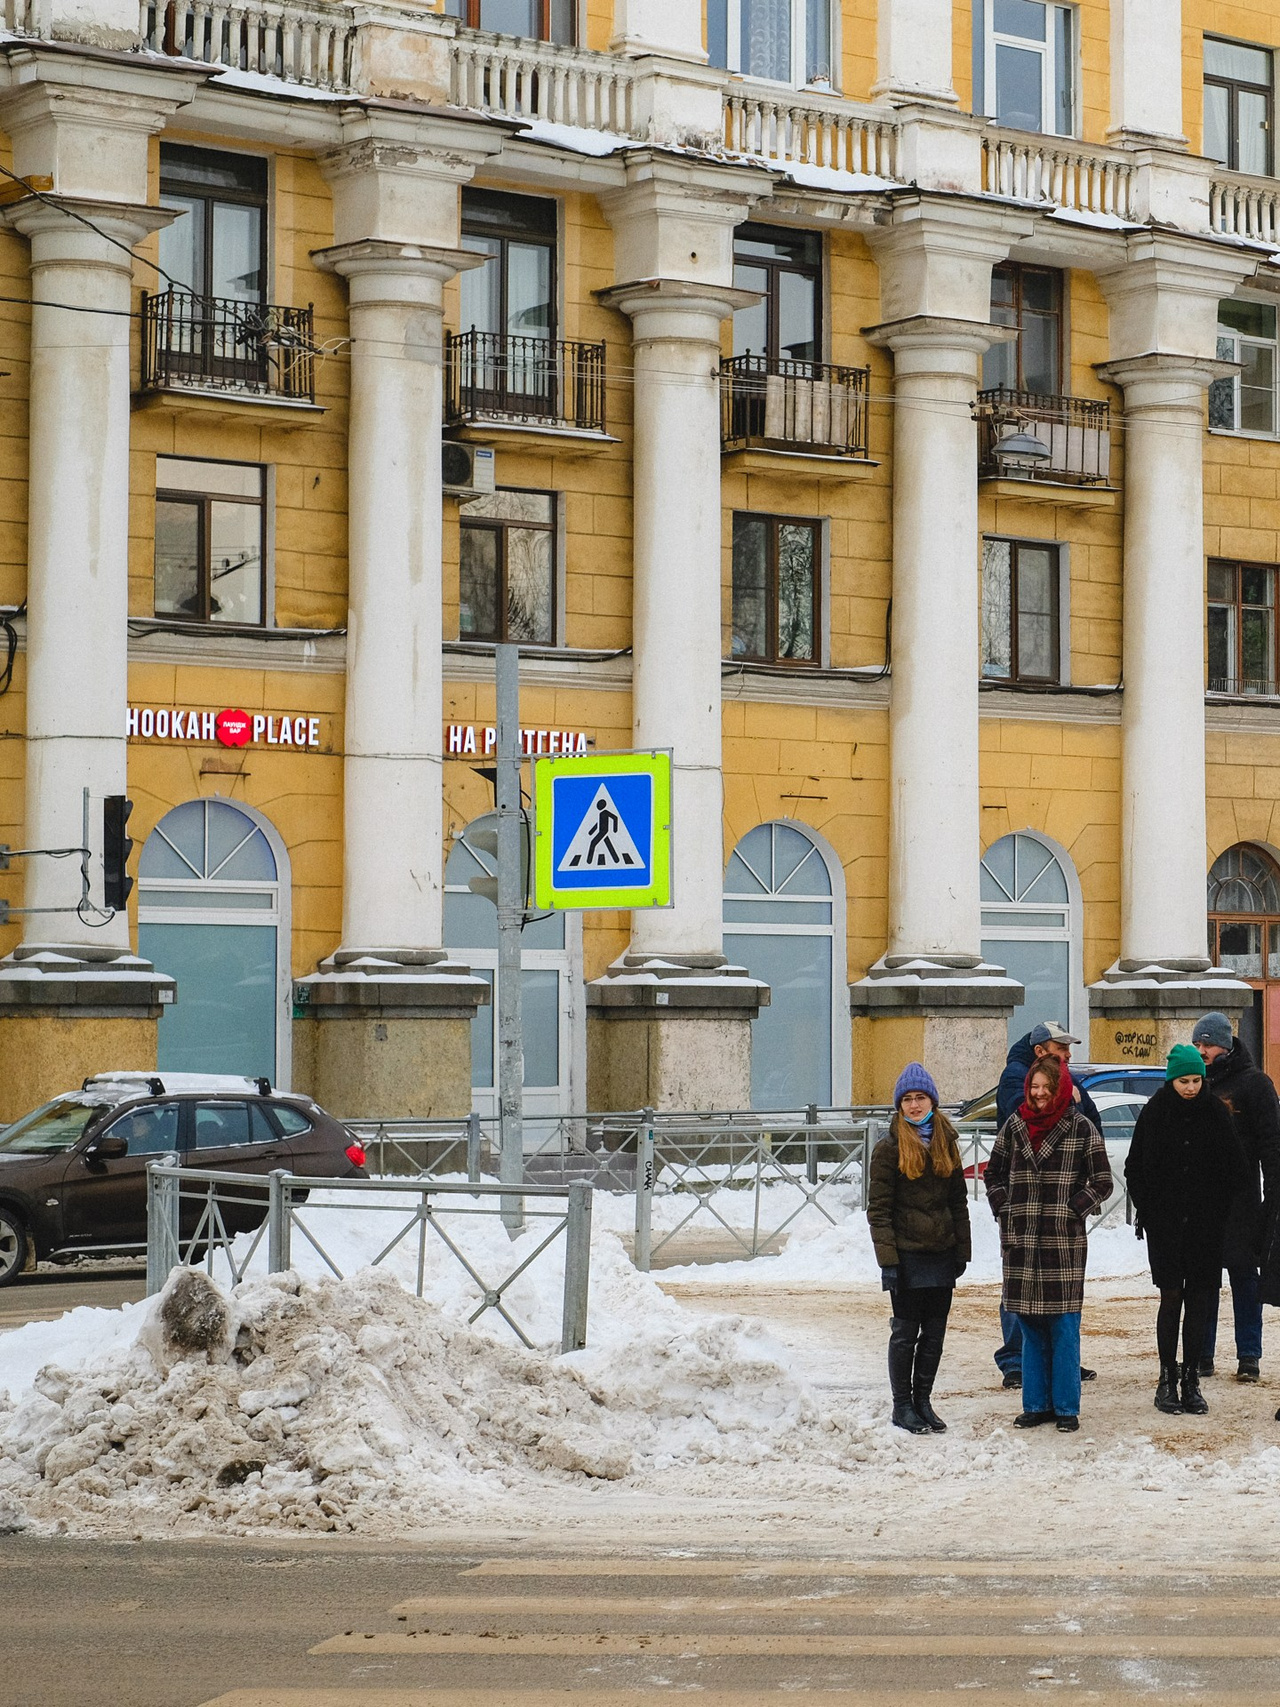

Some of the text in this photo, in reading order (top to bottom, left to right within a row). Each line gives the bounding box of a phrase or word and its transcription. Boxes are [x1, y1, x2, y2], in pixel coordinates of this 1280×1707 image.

[126, 708, 320, 746] HOOKAH PLACE
[450, 725, 587, 758] НА РТГЕНА
